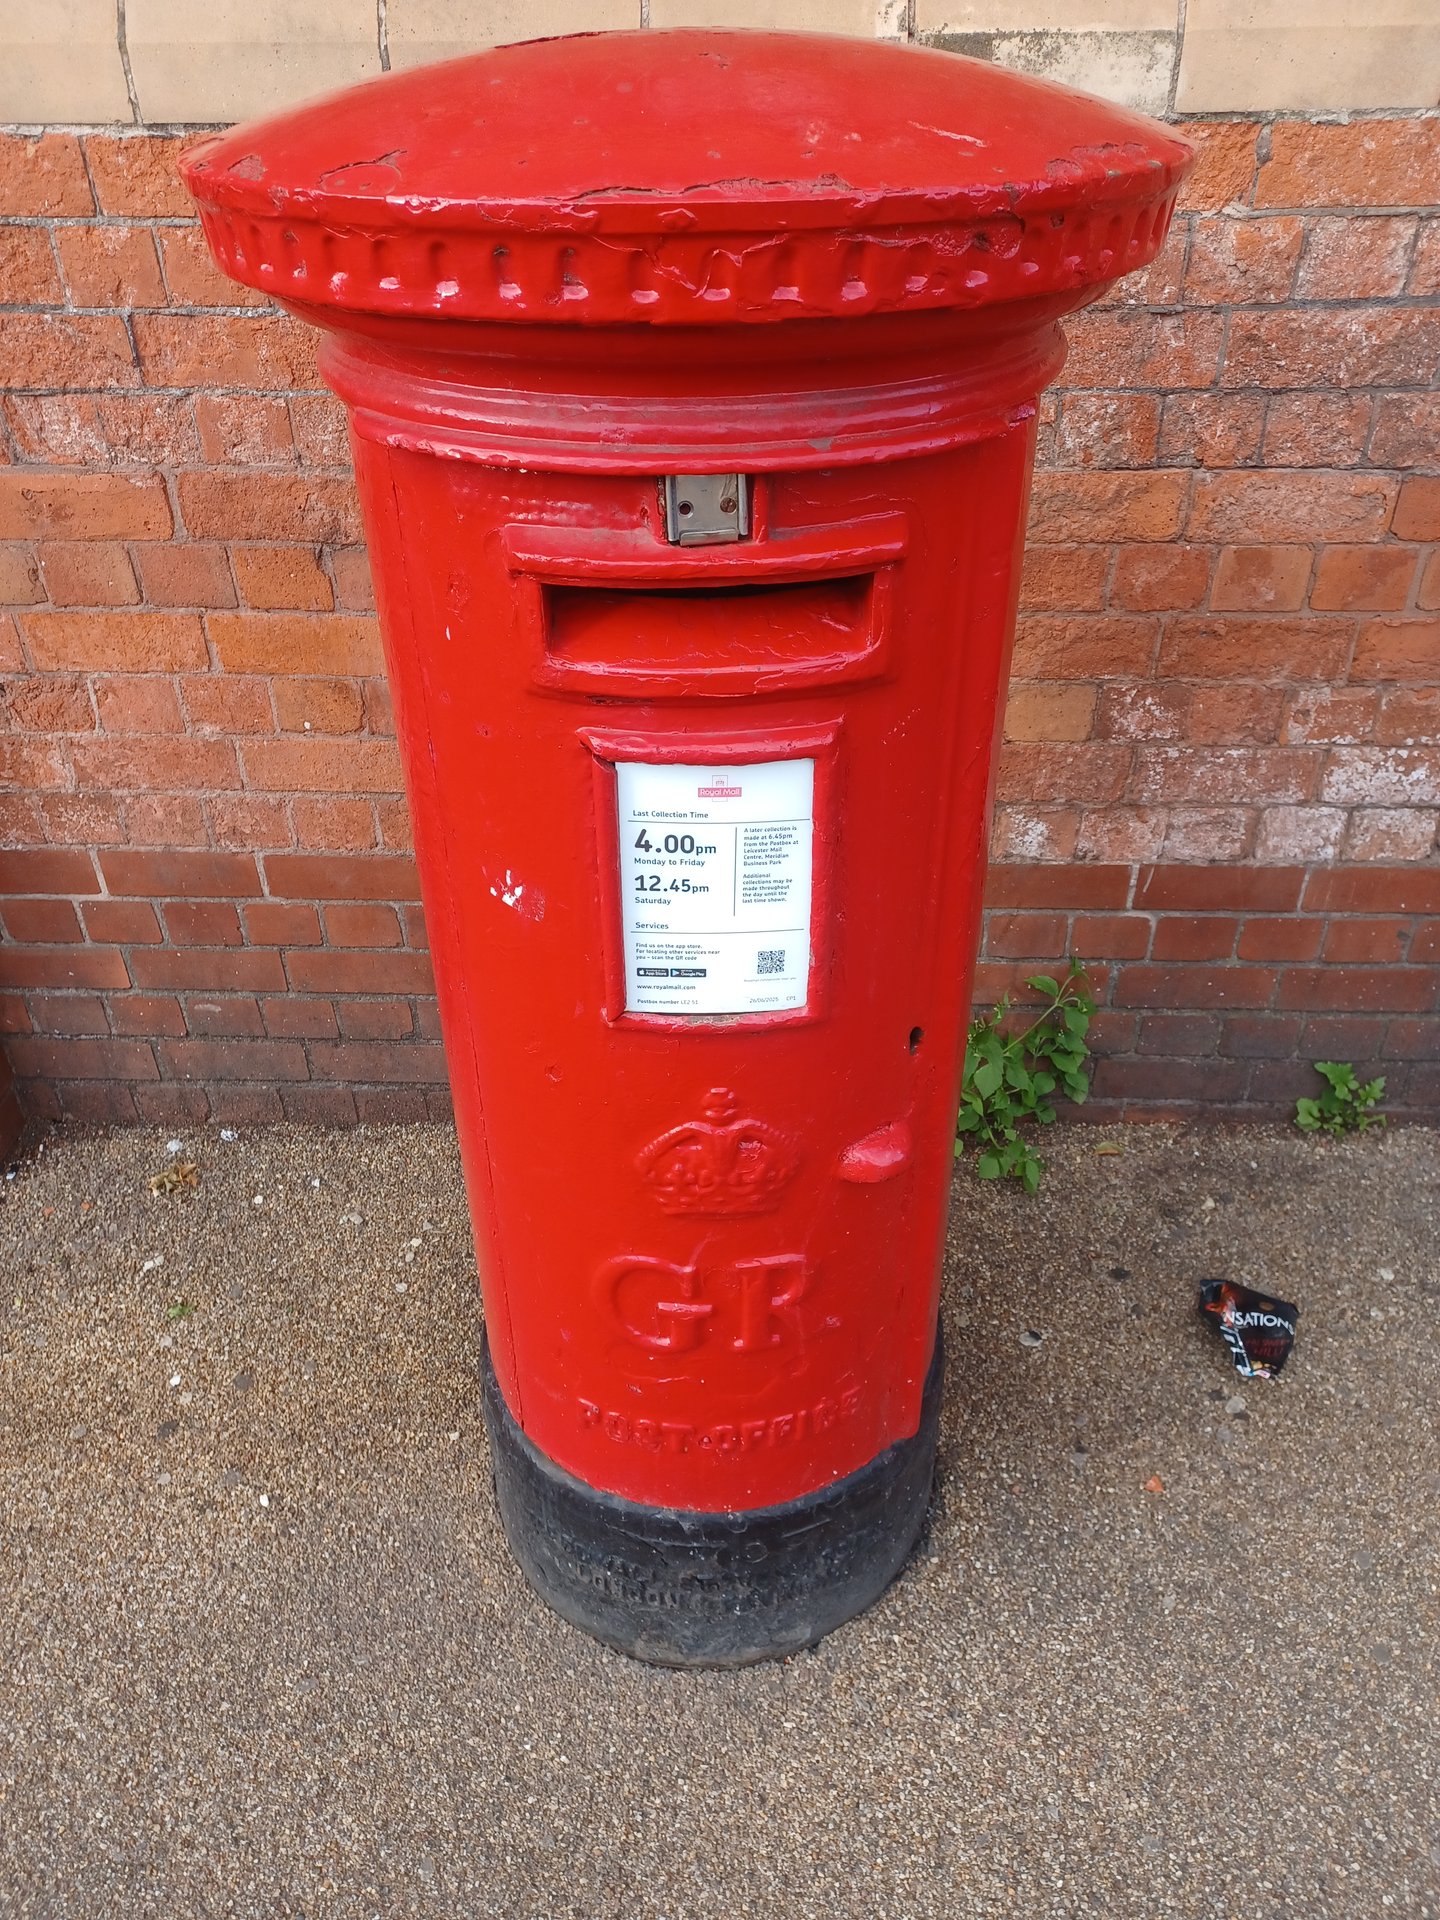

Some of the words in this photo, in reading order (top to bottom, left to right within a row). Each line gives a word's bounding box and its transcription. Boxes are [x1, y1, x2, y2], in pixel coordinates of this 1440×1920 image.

[700, 788, 722, 797] Royal
[723, 788, 741, 796] Mail
[651, 810, 688, 818] Collection
[690, 811, 709, 819] Time
[634, 828, 717, 857] 4.00pm
[634, 857, 666, 866] Monday
[679, 858, 706, 867] Friday
[634, 874, 709, 894] 12.45pm
[635, 896, 671, 905] Saturday
[635, 921, 669, 929] Services
